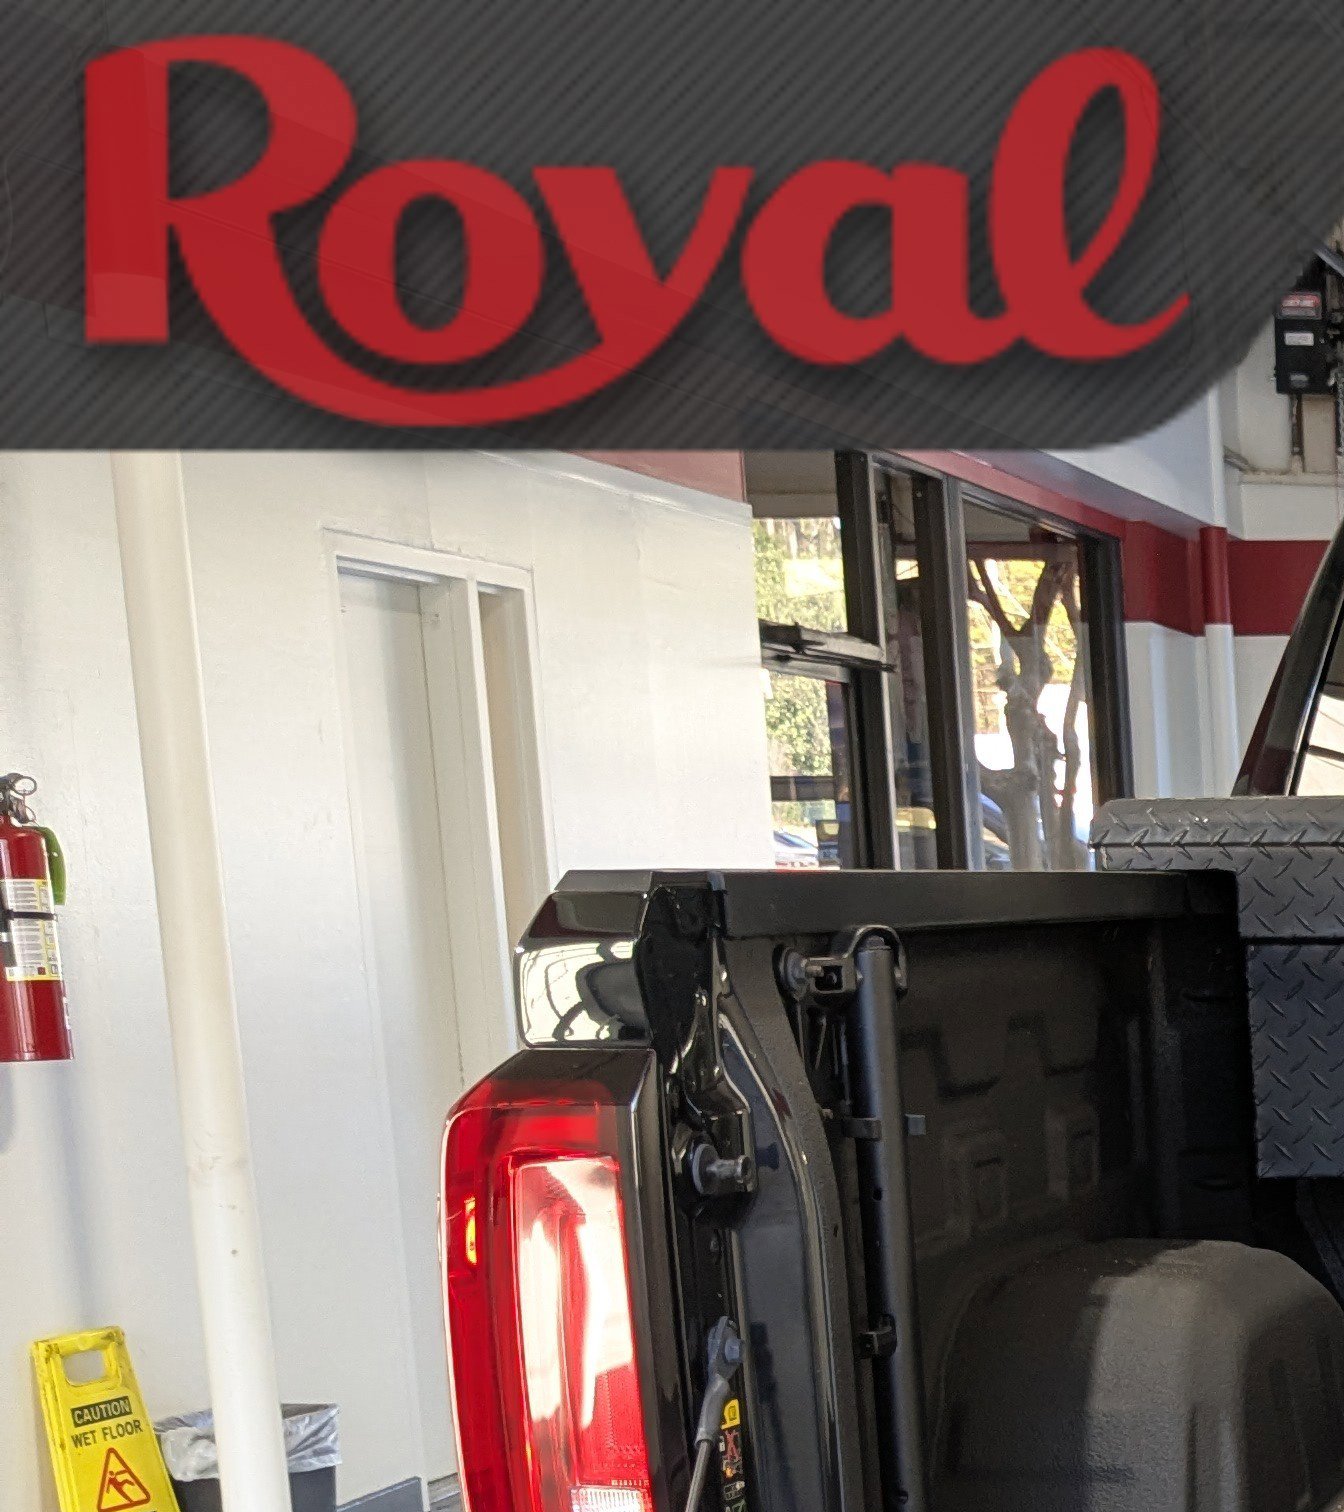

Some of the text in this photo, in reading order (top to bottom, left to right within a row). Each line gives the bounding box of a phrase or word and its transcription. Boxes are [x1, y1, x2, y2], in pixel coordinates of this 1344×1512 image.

[73, 1399, 131, 1425] CAUTION
[71, 1419, 143, 1449] WET FLOOR
